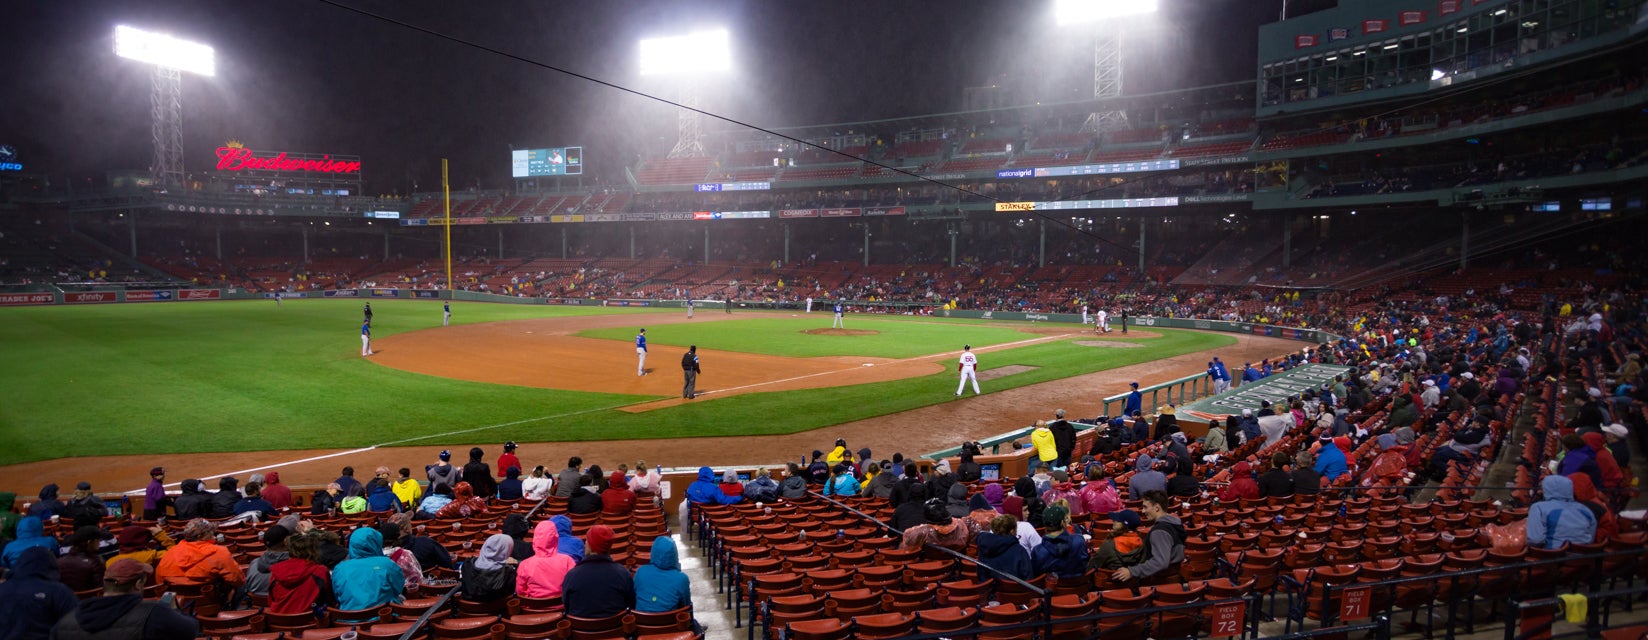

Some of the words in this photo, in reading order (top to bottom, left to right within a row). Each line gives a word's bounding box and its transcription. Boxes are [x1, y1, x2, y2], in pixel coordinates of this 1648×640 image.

[215, 147, 361, 173] Budweiser
[998, 169, 1032, 177] nationalgrid
[77, 293, 104, 301] xfinity
[1345, 604, 1360, 616] 71
[1218, 620, 1237, 633] 72
